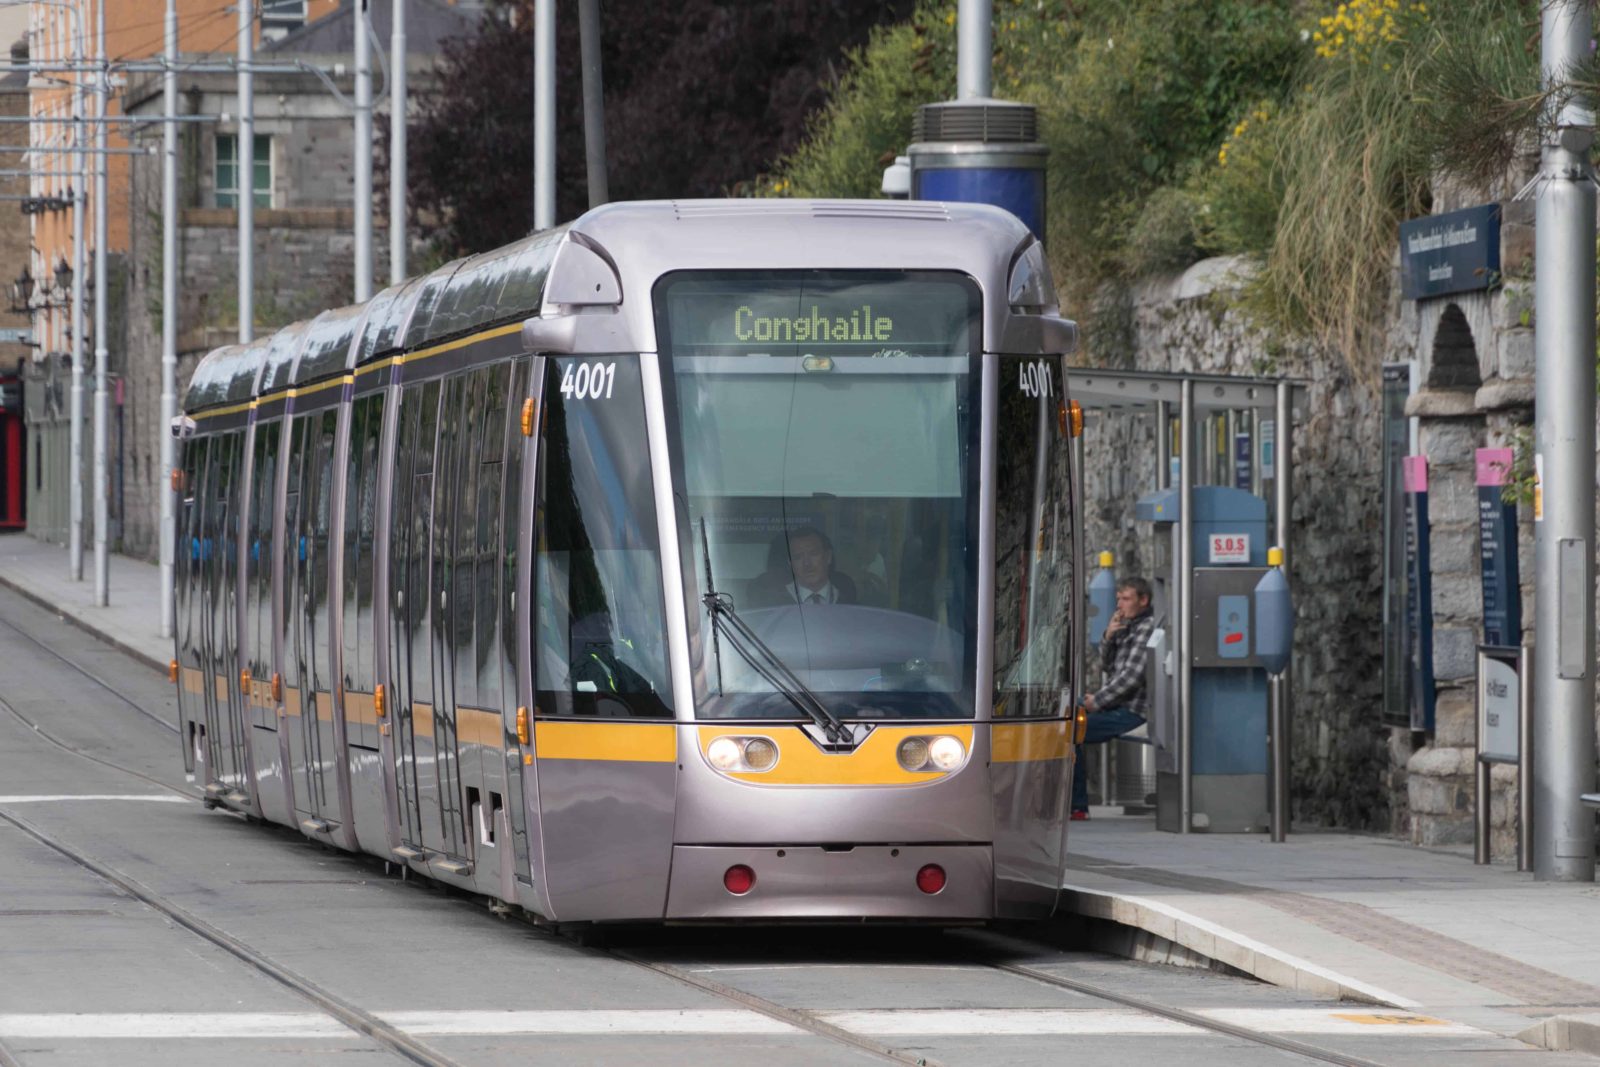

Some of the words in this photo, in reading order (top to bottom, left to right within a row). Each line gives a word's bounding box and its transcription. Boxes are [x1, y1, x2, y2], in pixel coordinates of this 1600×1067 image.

[735, 306, 892, 341] Conghaile
[560, 362, 616, 399] 4001
[1020, 362, 1054, 398] 4001
